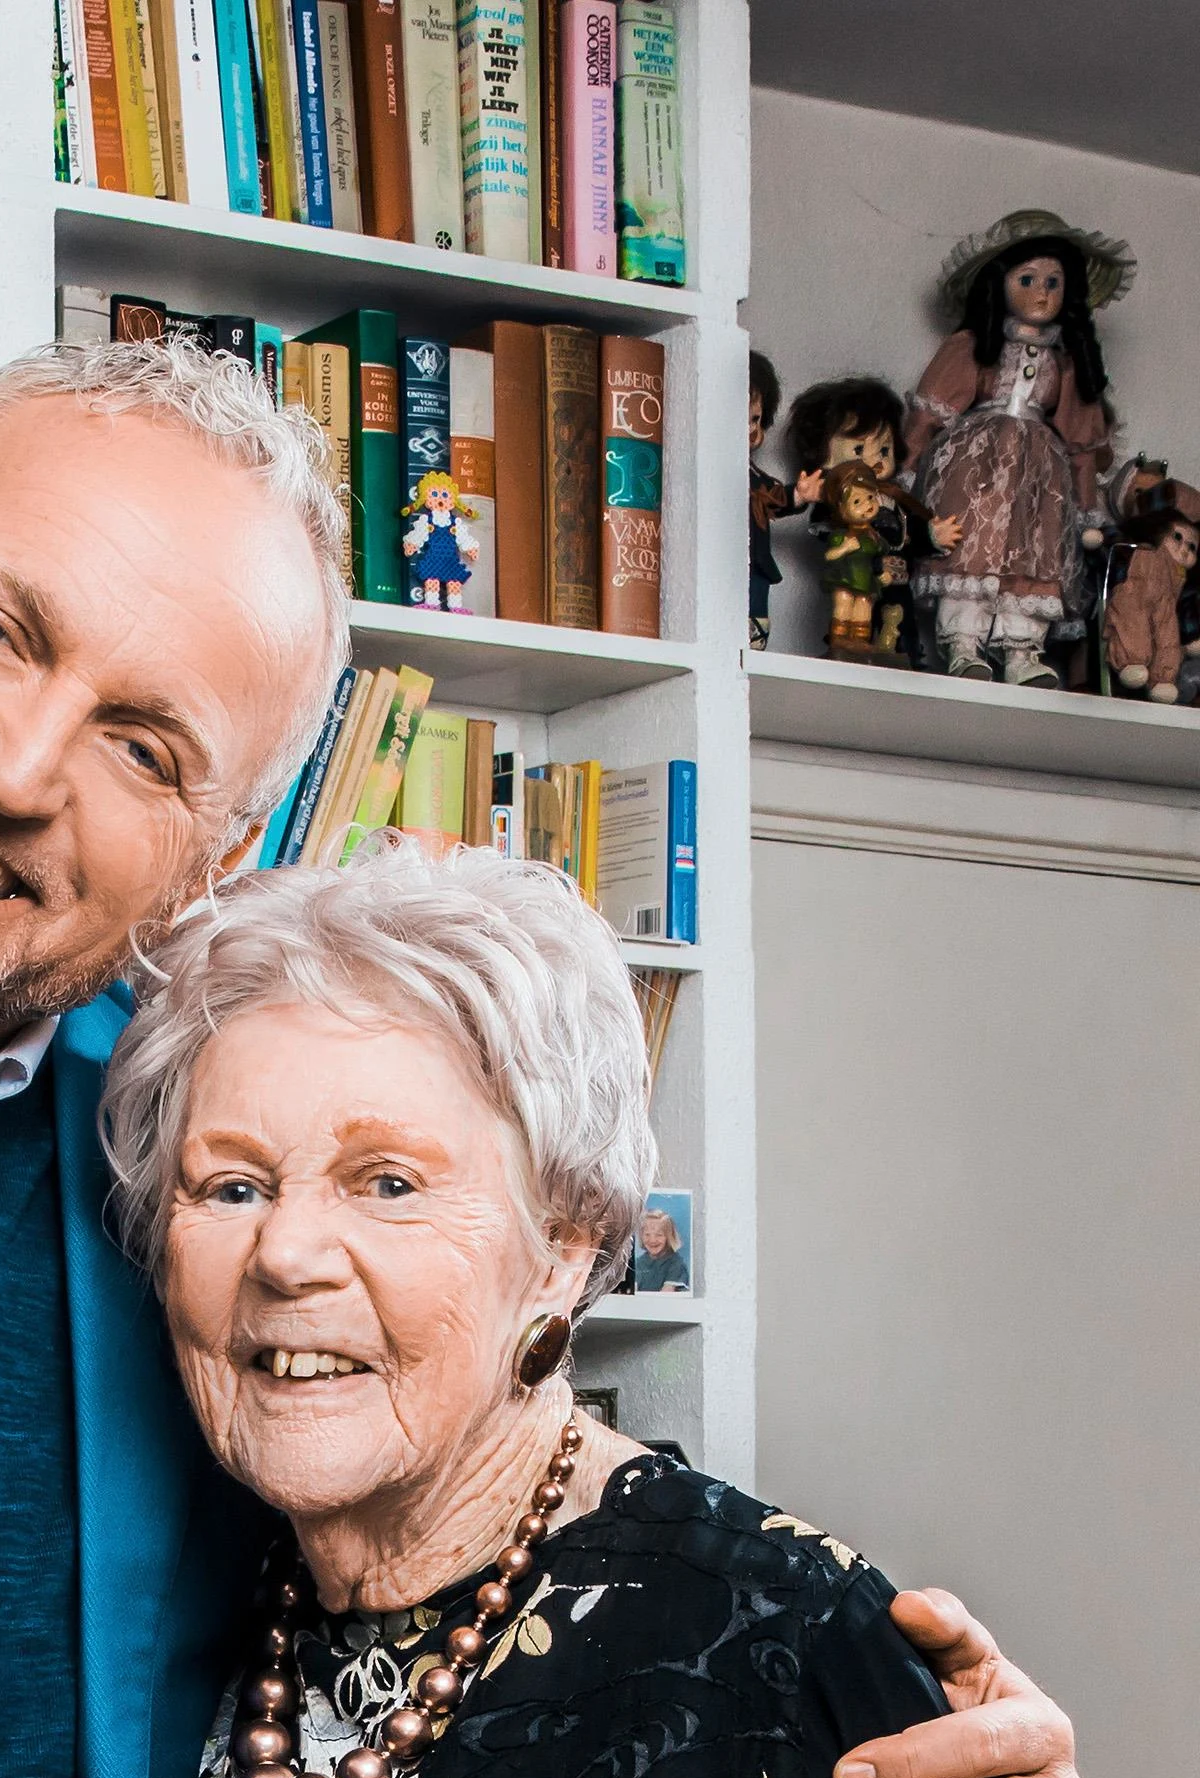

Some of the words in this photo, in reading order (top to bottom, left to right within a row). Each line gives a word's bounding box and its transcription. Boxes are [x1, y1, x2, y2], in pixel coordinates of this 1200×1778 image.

[411, 18, 426, 27] van
[428, 5, 440, 17] Jos
[303, 11, 314, 47] Isabel
[422, 29, 449, 42] Pieters
[488, 27, 503, 39] JE
[385, 44, 395, 75] BOZE
[483, 41, 518, 56] WEET
[586, 14, 600, 86] COOKSON
[599, 15, 611, 88] CATHERINE
[305, 50, 317, 94] Allende
[490, 56, 518, 71] NIET
[330, 62, 343, 100] JONG
[483, 70, 511, 83] WAT
[489, 85, 505, 97] JE
[481, 99, 519, 114] LEEST
[68, 105, 79, 139] Liefde
[421, 108, 431, 146] Trilogie
[311, 134, 319, 150] van
[502, 136, 521, 153] het
[591, 98, 608, 178] HANNAH
[71, 142, 80, 168] liegt
[591, 184, 608, 236] JINNY
[319, 353, 332, 427] kosmos
[607, 368, 663, 393] UMBERTO
[377, 392, 389, 402] IN
[611, 390, 661, 439] ECO
[608, 508, 629, 524] DE
[616, 545, 659, 572] ROOS
[306, 783, 320, 804] huis
